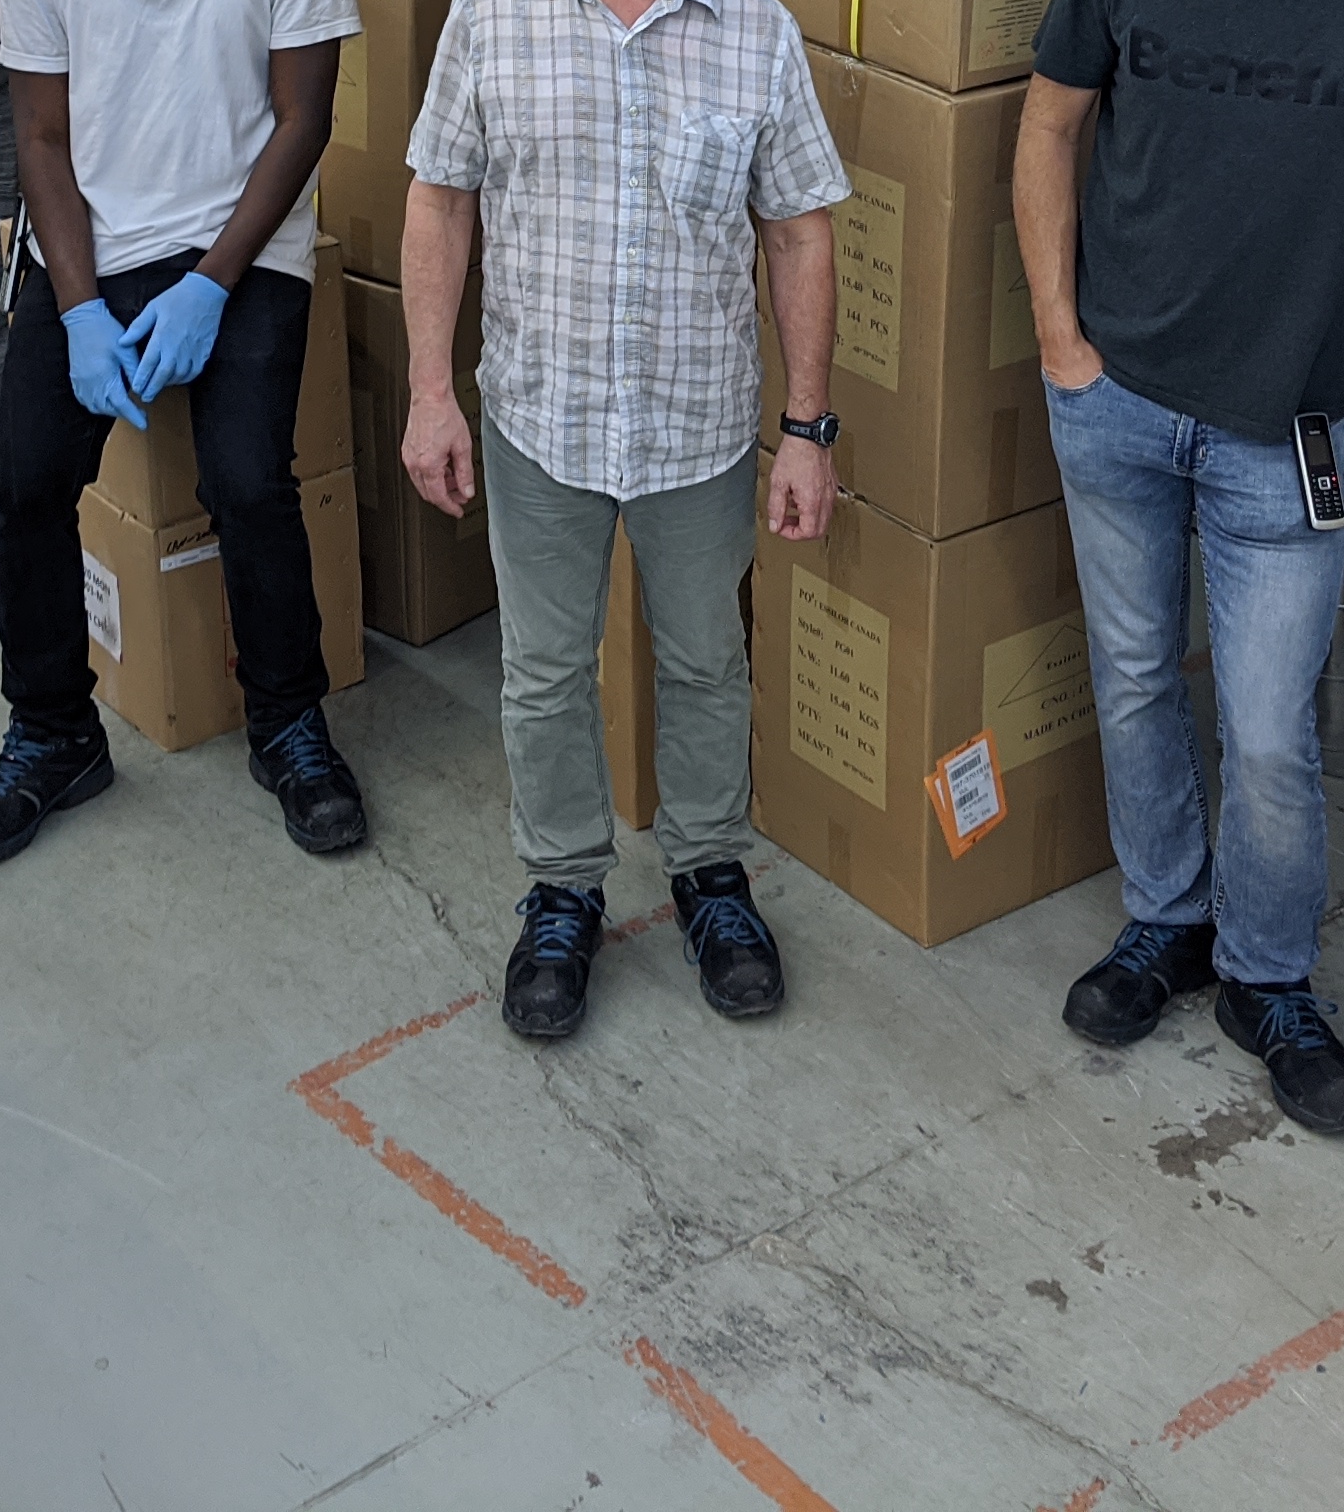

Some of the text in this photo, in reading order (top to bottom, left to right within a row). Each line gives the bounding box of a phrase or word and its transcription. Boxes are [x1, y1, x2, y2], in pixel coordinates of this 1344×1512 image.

[864, 194, 896, 215] CANADA
[873, 257, 893, 275] KGS
[873, 289, 893, 306] KGS
[847, 308, 888, 335] 144 PCS
[850, 620, 881, 644] CANADA
[859, 682, 879, 701] KGS
[859, 710, 879, 729] KGS
[1024, 722, 1053, 740] MADE
[1058, 716, 1069, 728] IN
[836, 724, 848, 740] 144
[858, 738, 876, 756] PCS
